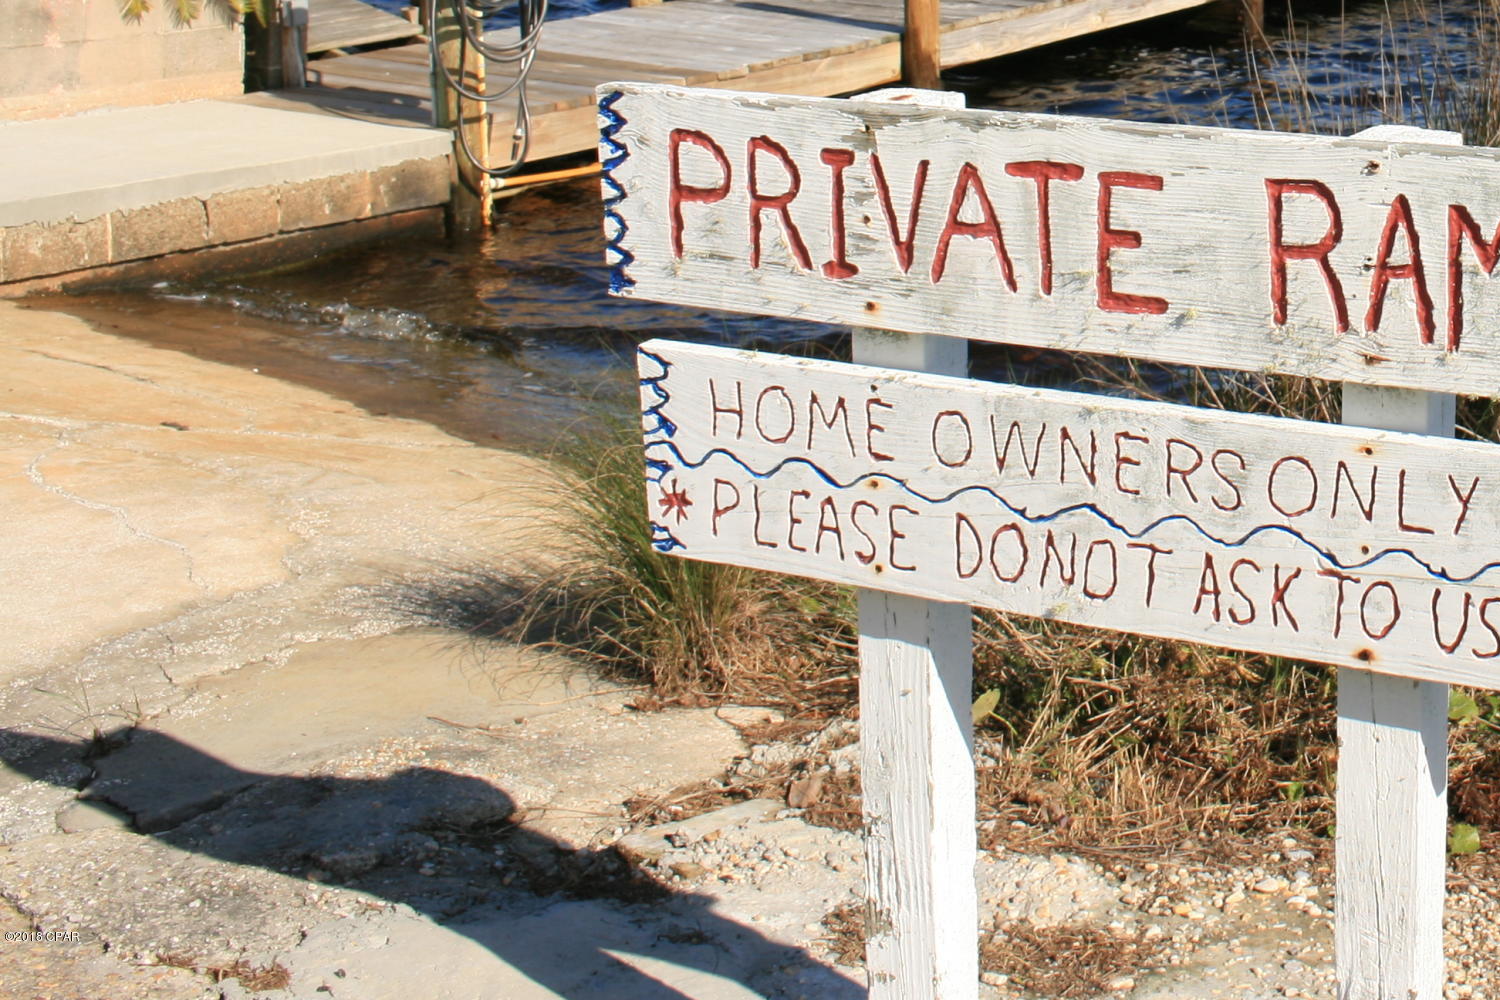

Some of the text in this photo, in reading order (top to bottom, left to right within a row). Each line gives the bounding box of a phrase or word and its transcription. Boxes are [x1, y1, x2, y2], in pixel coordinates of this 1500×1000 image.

[668, 127, 1171, 315] PRIVATE
[709, 378, 894, 462] HOME
[931, 410, 1246, 511] OWNERS
[712, 477, 919, 572] PLEASE
[1193, 551, 1302, 632] ASK
[1317, 568, 1401, 640] TO
